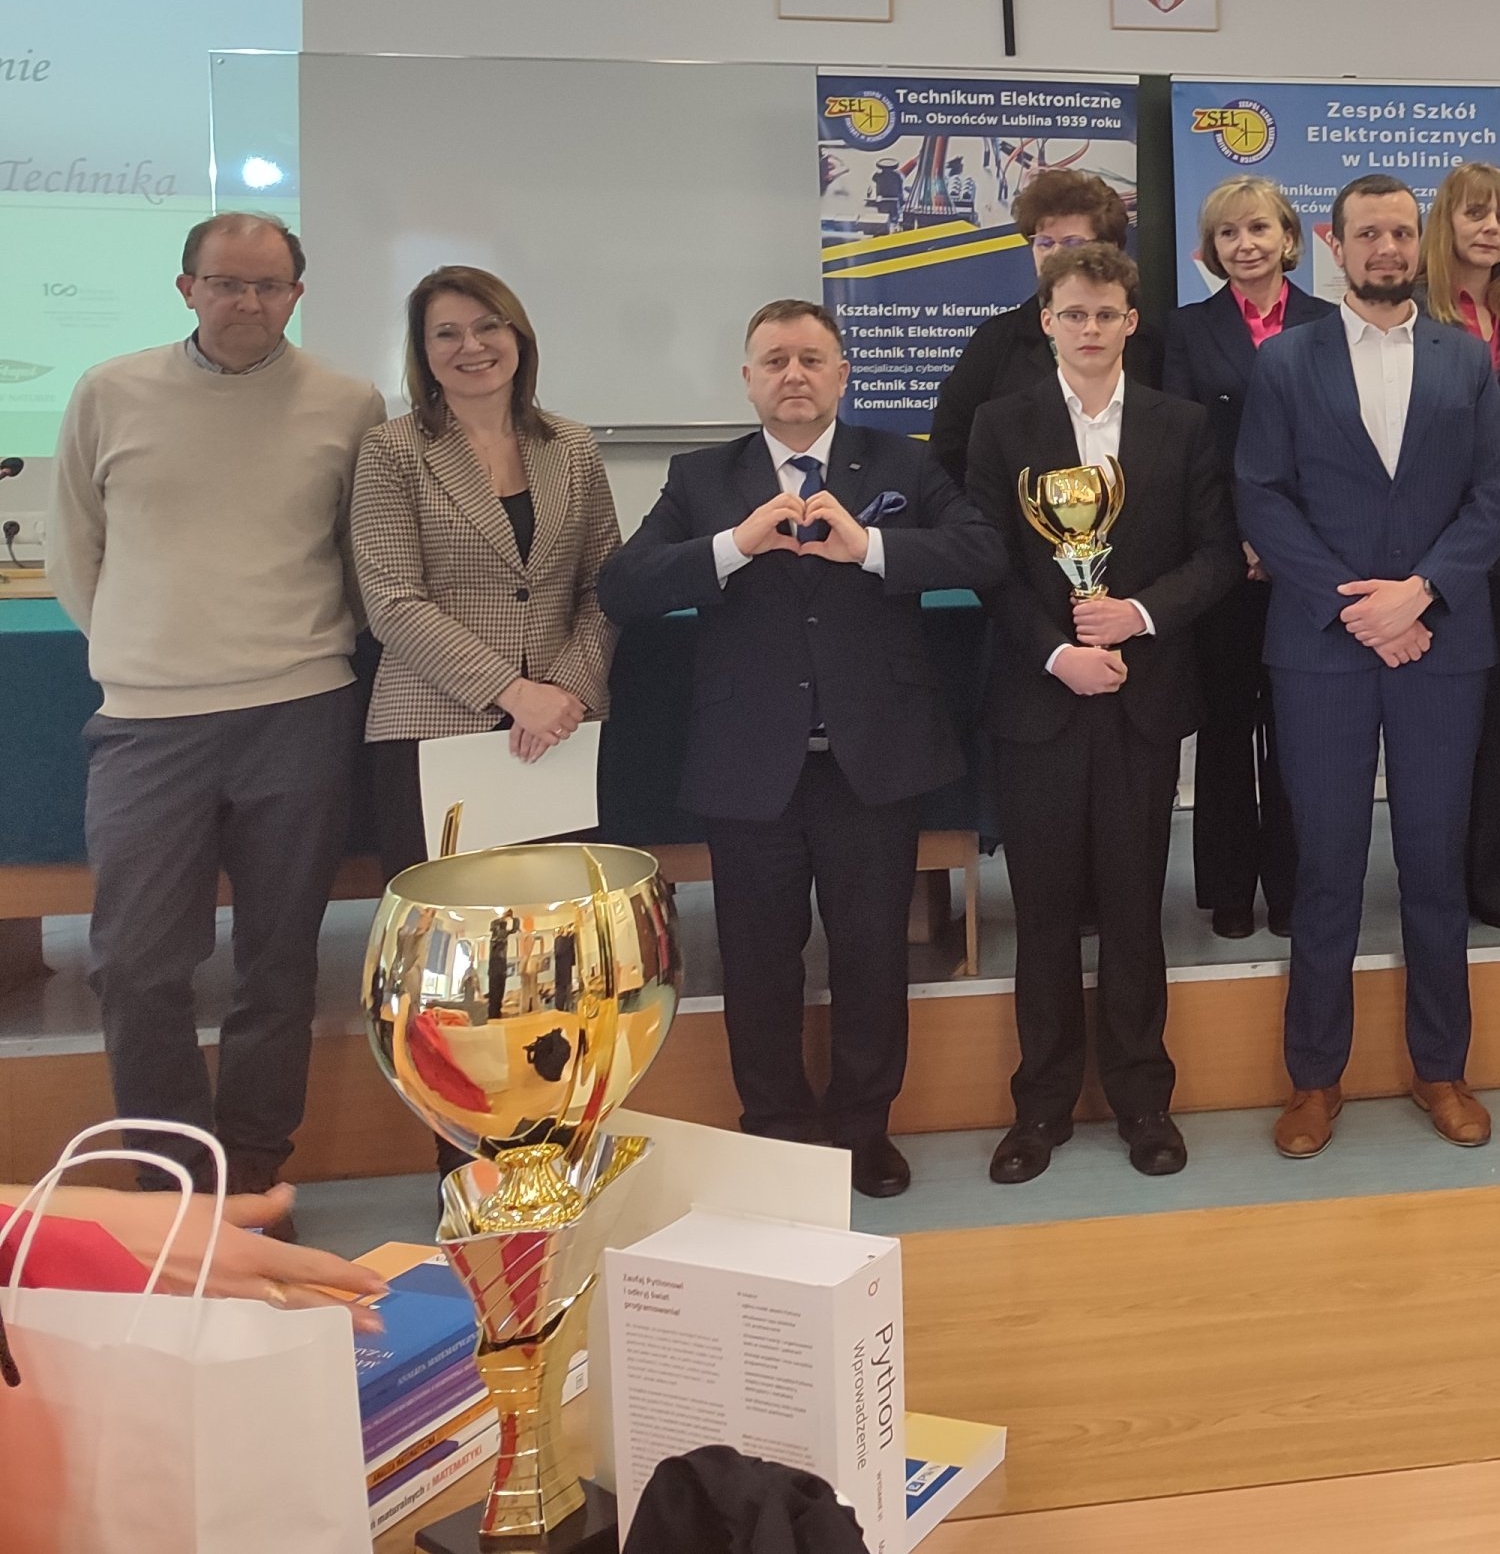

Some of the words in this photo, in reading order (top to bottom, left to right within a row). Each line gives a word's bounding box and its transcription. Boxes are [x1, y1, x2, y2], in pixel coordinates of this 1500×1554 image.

[826, 98, 865, 115] ZSEL
[895, 89, 994, 106] Technikum
[1000, 91, 1121, 109] Elektroniczne
[901, 112, 921, 124] im.
[926, 112, 998, 125] Obrońców
[1002, 114, 1052, 126] Lublina
[1056, 115, 1087, 127] 1939
[1091, 117, 1121, 128] roku
[1193, 110, 1240, 131] ZSEL
[1327, 101, 1405, 122] Zespół
[1413, 102, 1476, 120] Szkół
[1307, 126, 1496, 147] Elektronicznych
[1342, 154, 1360, 167] w
[1368, 152, 1463, 168] Lublinie
[0, 157, 178, 205] Technika
[836, 303, 920, 318] Kształcimy
[925, 306, 938, 316] w
[850, 326, 904, 338] Technik
[850, 347, 904, 359] Technik
[908, 346, 963, 359] Teleinfo
[852, 364, 913, 374] specjalizacja
[852, 379, 906, 391] Technik
[871, 1321, 896, 1450] Python
[850, 1338, 868, 1470] Wprowadzenie
[431, 1444, 483, 1487] MATEMATYKI
